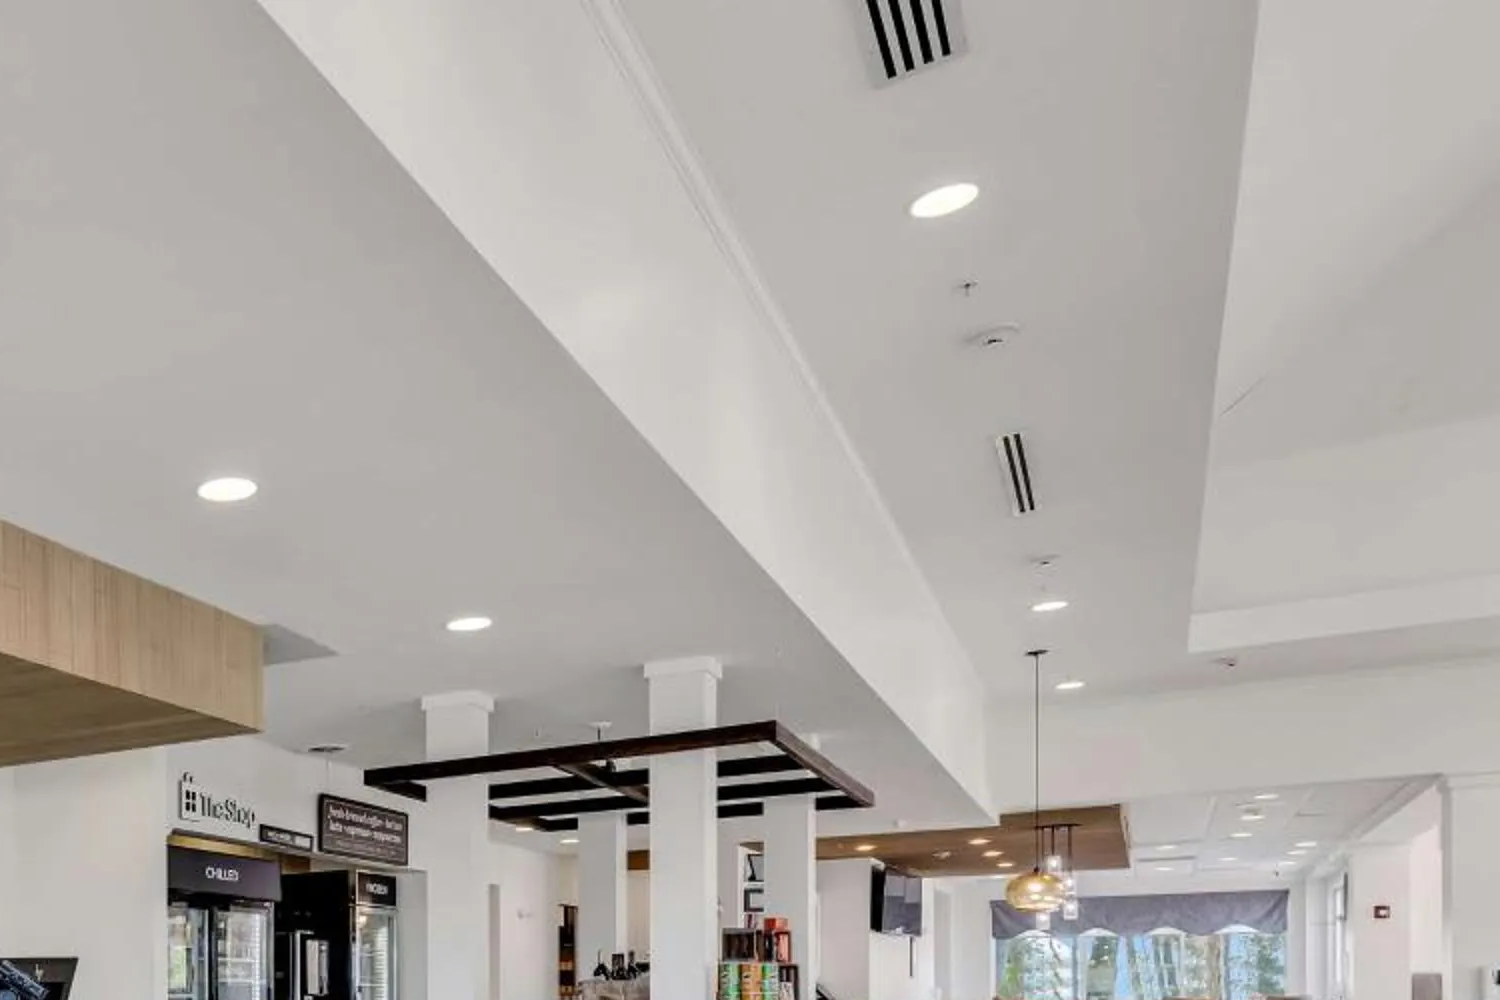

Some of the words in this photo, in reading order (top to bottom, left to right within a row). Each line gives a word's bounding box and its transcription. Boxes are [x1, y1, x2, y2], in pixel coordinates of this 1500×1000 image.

[199, 792, 224, 819] The
[224, 799, 256, 828] Shop
[205, 866, 239, 881] CHILLED
